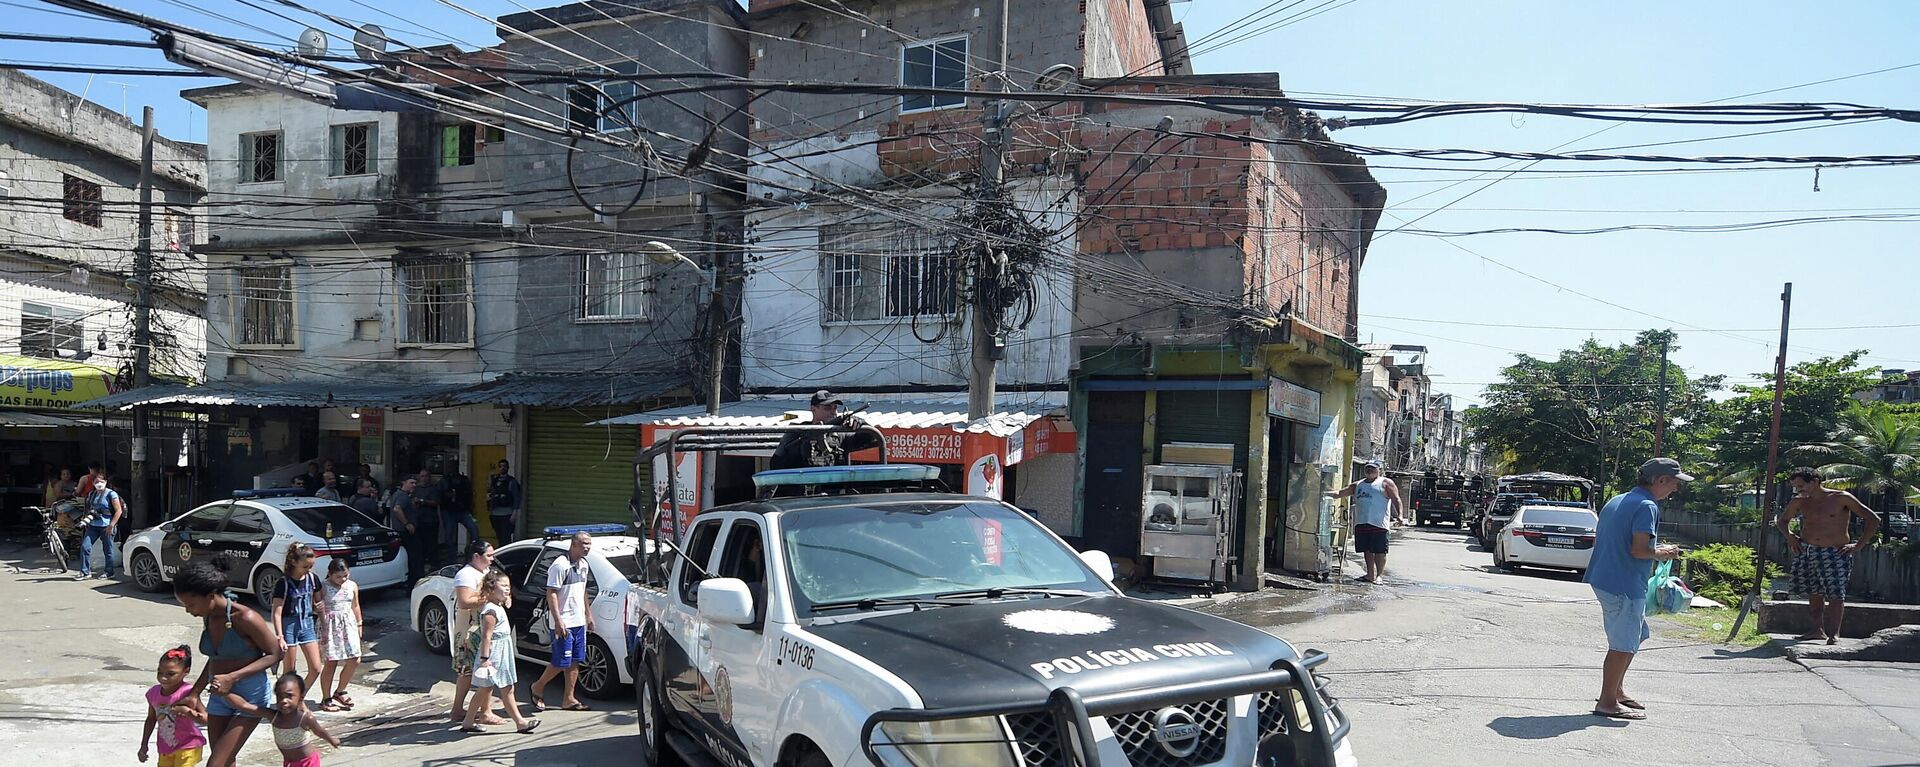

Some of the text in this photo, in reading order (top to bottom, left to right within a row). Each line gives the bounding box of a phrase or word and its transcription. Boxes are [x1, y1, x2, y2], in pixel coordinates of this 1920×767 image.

[25, 397, 43, 407] EM
[892, 434, 962, 447] 96649-8718
[892, 447, 924, 458] 3065-5402
[928, 447, 961, 460] 3072-9714
[608, 590, 619, 598] DP
[778, 635, 816, 671] 11-0136
[1030, 641, 1234, 680] POLÍCIA CIVIL
[1163, 726, 1198, 740] NISSAN
